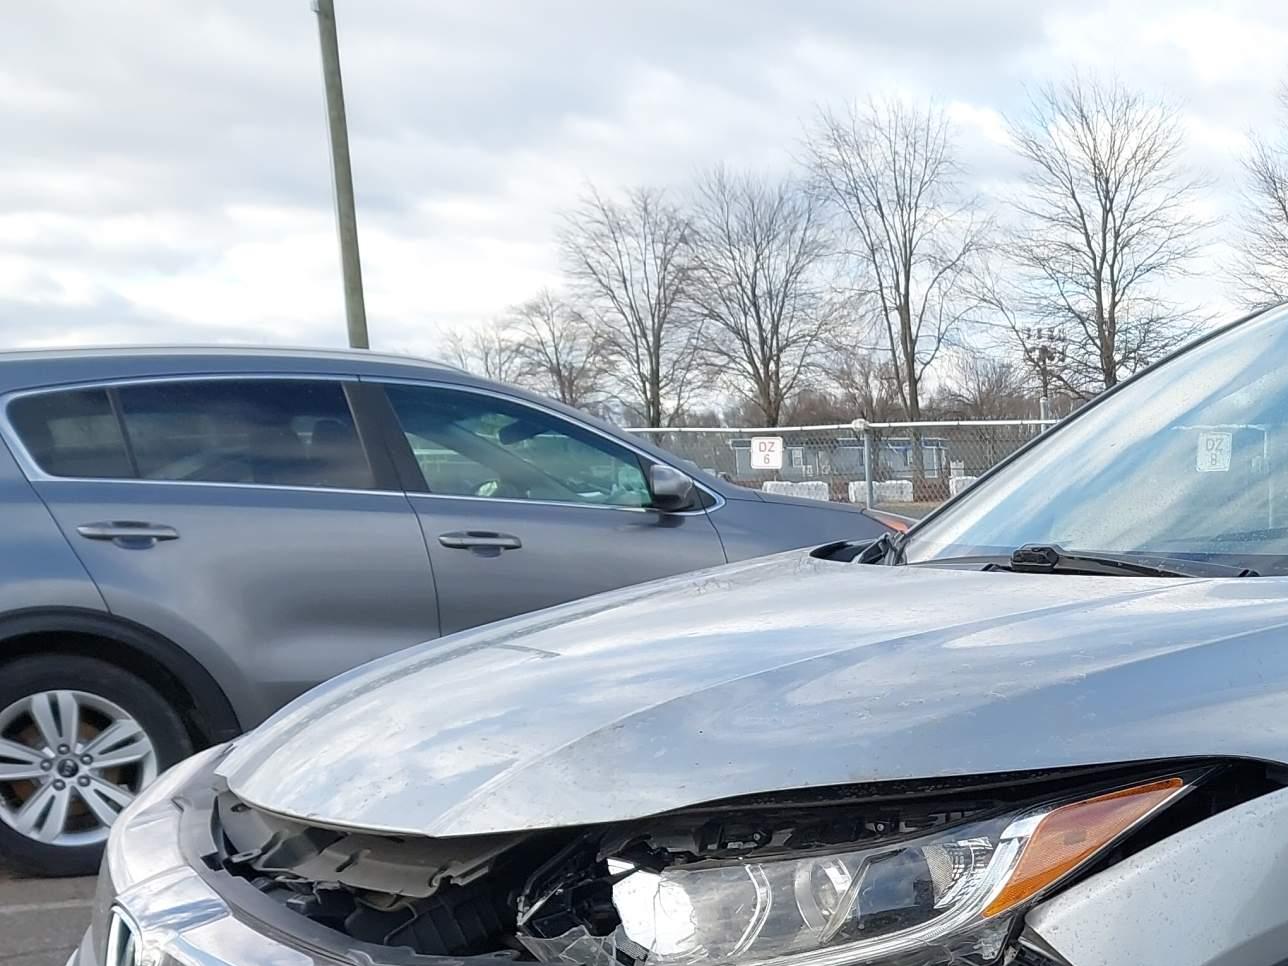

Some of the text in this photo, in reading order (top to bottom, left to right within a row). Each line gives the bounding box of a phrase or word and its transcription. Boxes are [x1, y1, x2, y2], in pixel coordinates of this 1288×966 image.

[758, 441, 776, 452] DZ
[1206, 438, 1225, 451] DZ
[763, 453, 770, 465] 6
